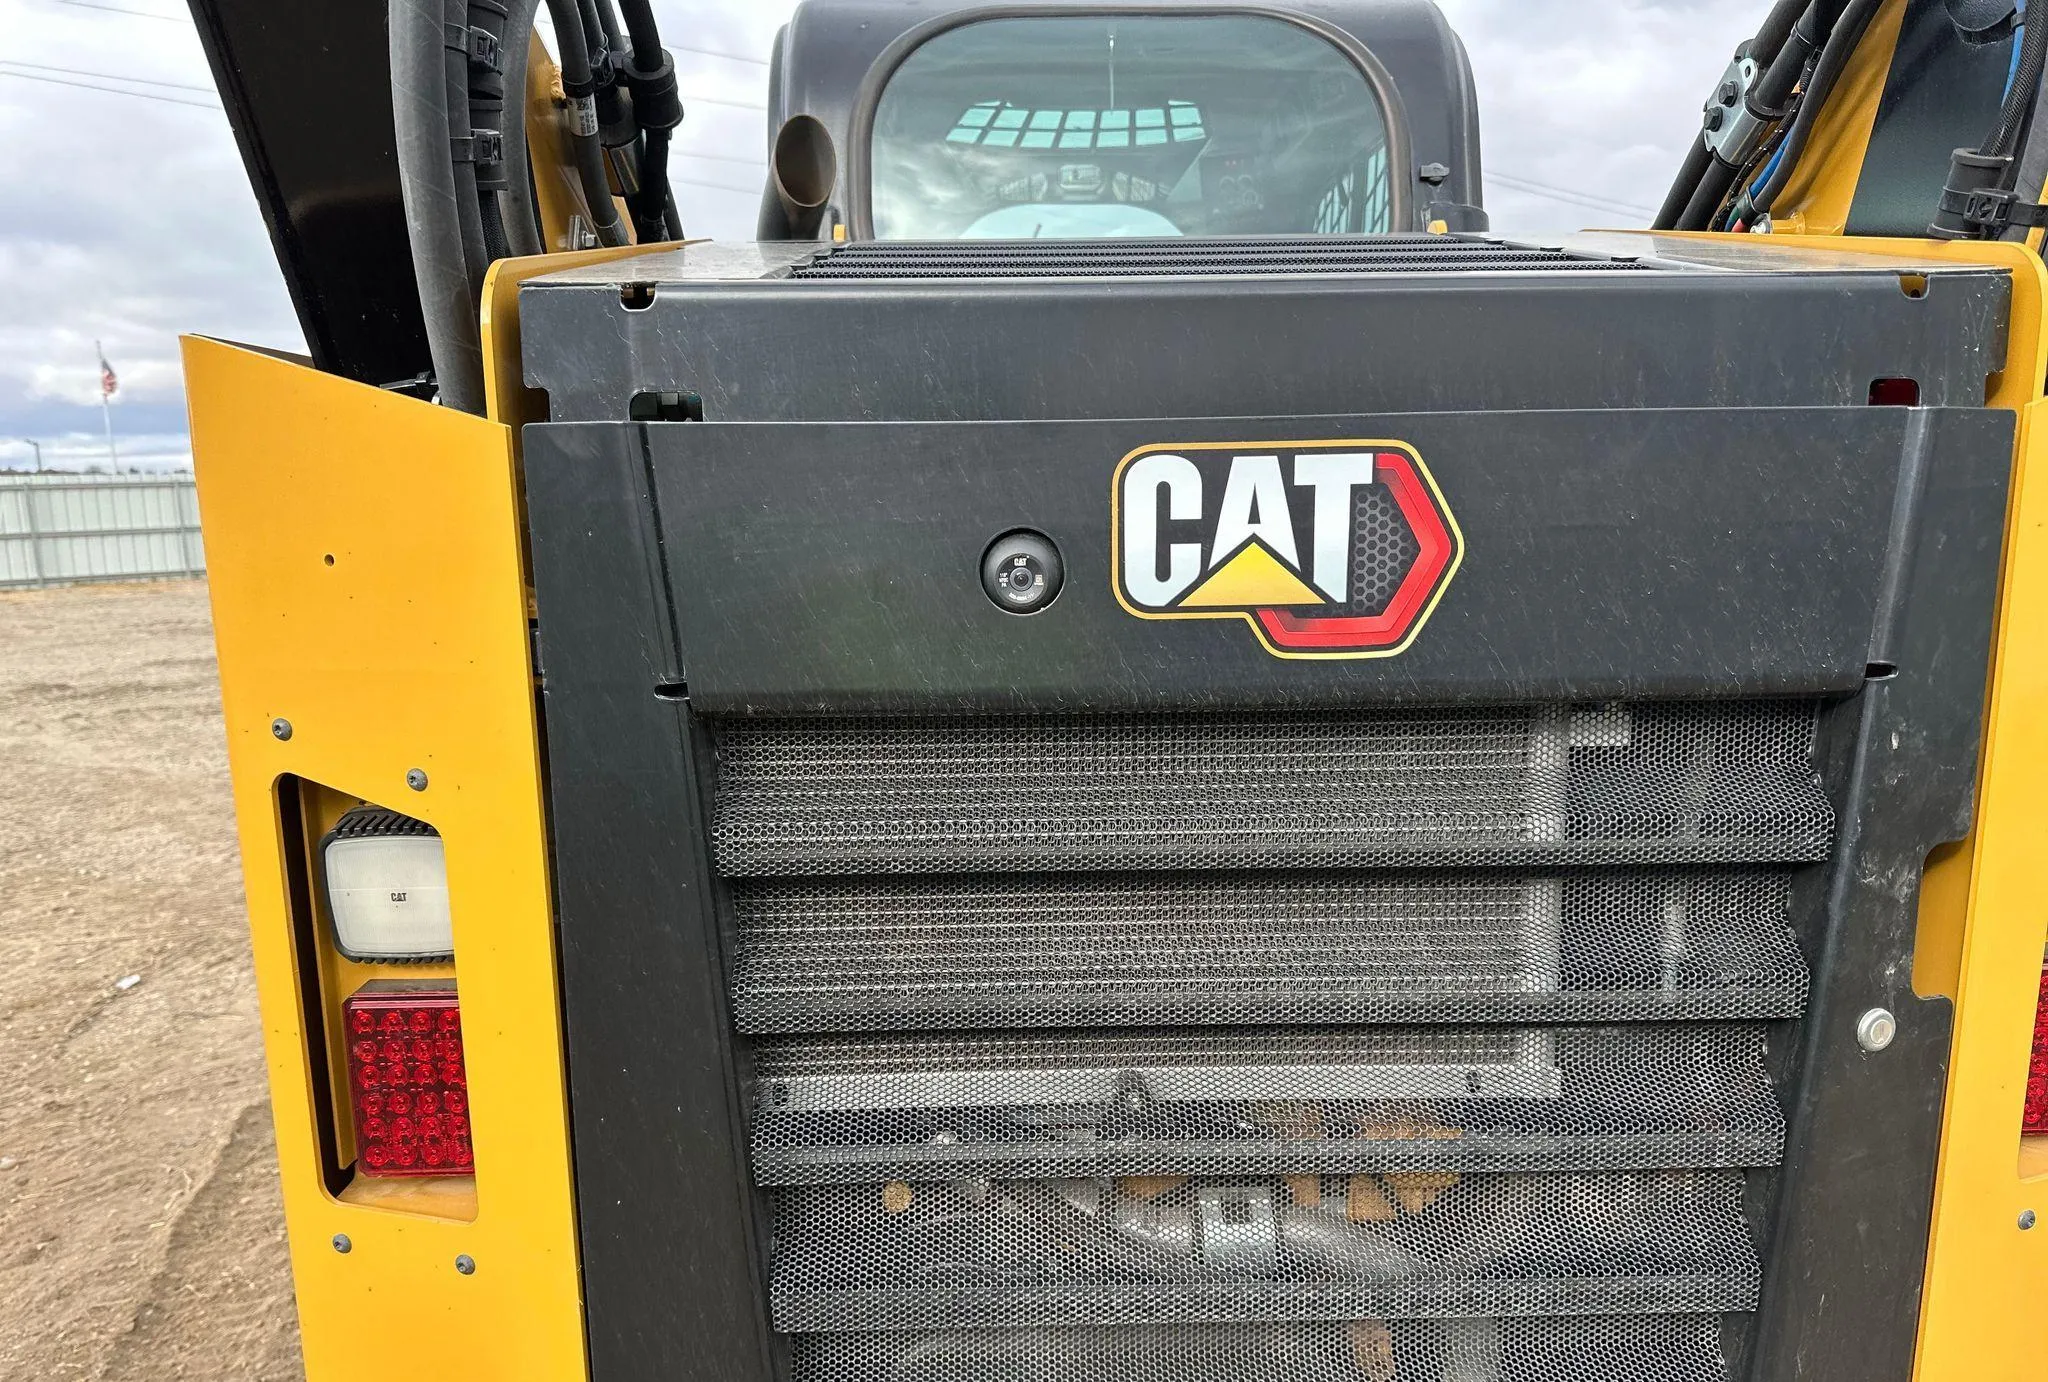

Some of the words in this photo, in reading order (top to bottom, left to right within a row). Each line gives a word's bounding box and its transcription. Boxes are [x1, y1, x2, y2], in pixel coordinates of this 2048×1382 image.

[1124, 453, 1373, 607] CAT
[1014, 557, 1027, 566] CAT
[391, 892, 406, 901] CAT
